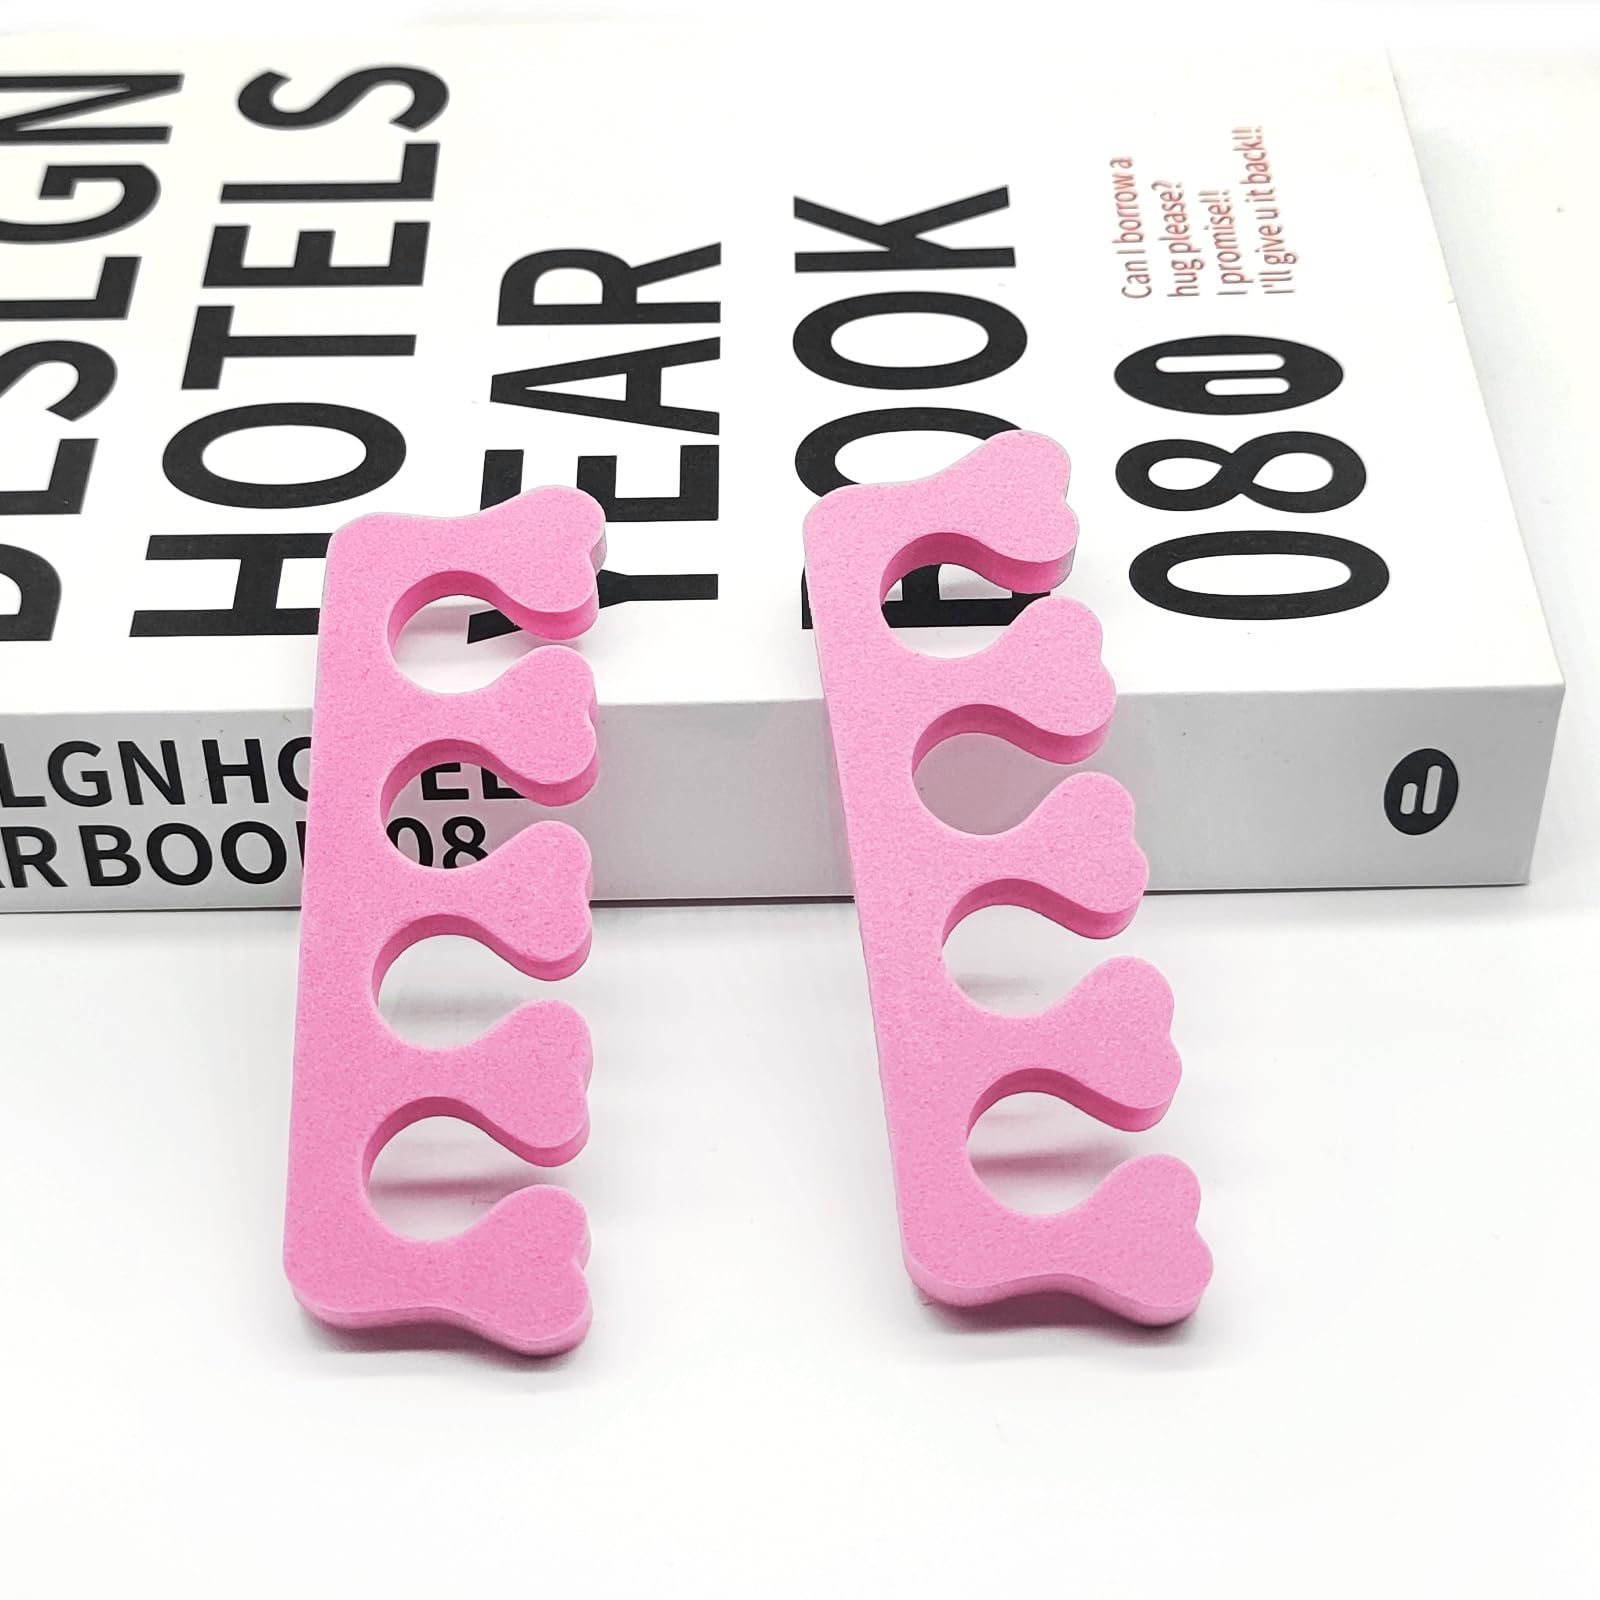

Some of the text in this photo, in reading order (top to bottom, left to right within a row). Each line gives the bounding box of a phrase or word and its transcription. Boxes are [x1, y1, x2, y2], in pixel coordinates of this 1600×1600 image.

[1109, 156, 1134, 170] a
[1111, 173, 1144, 244] borrow
[1151, 179, 1206, 298] hug please?
[1198, 189, 1255, 285] promise!!
[1231, 125, 1298, 295] I'll give u it back!!
[1121, 259, 1152, 299] Can
[129, 63, 450, 638] HOTELS
[79, 821, 307, 887] BOO
